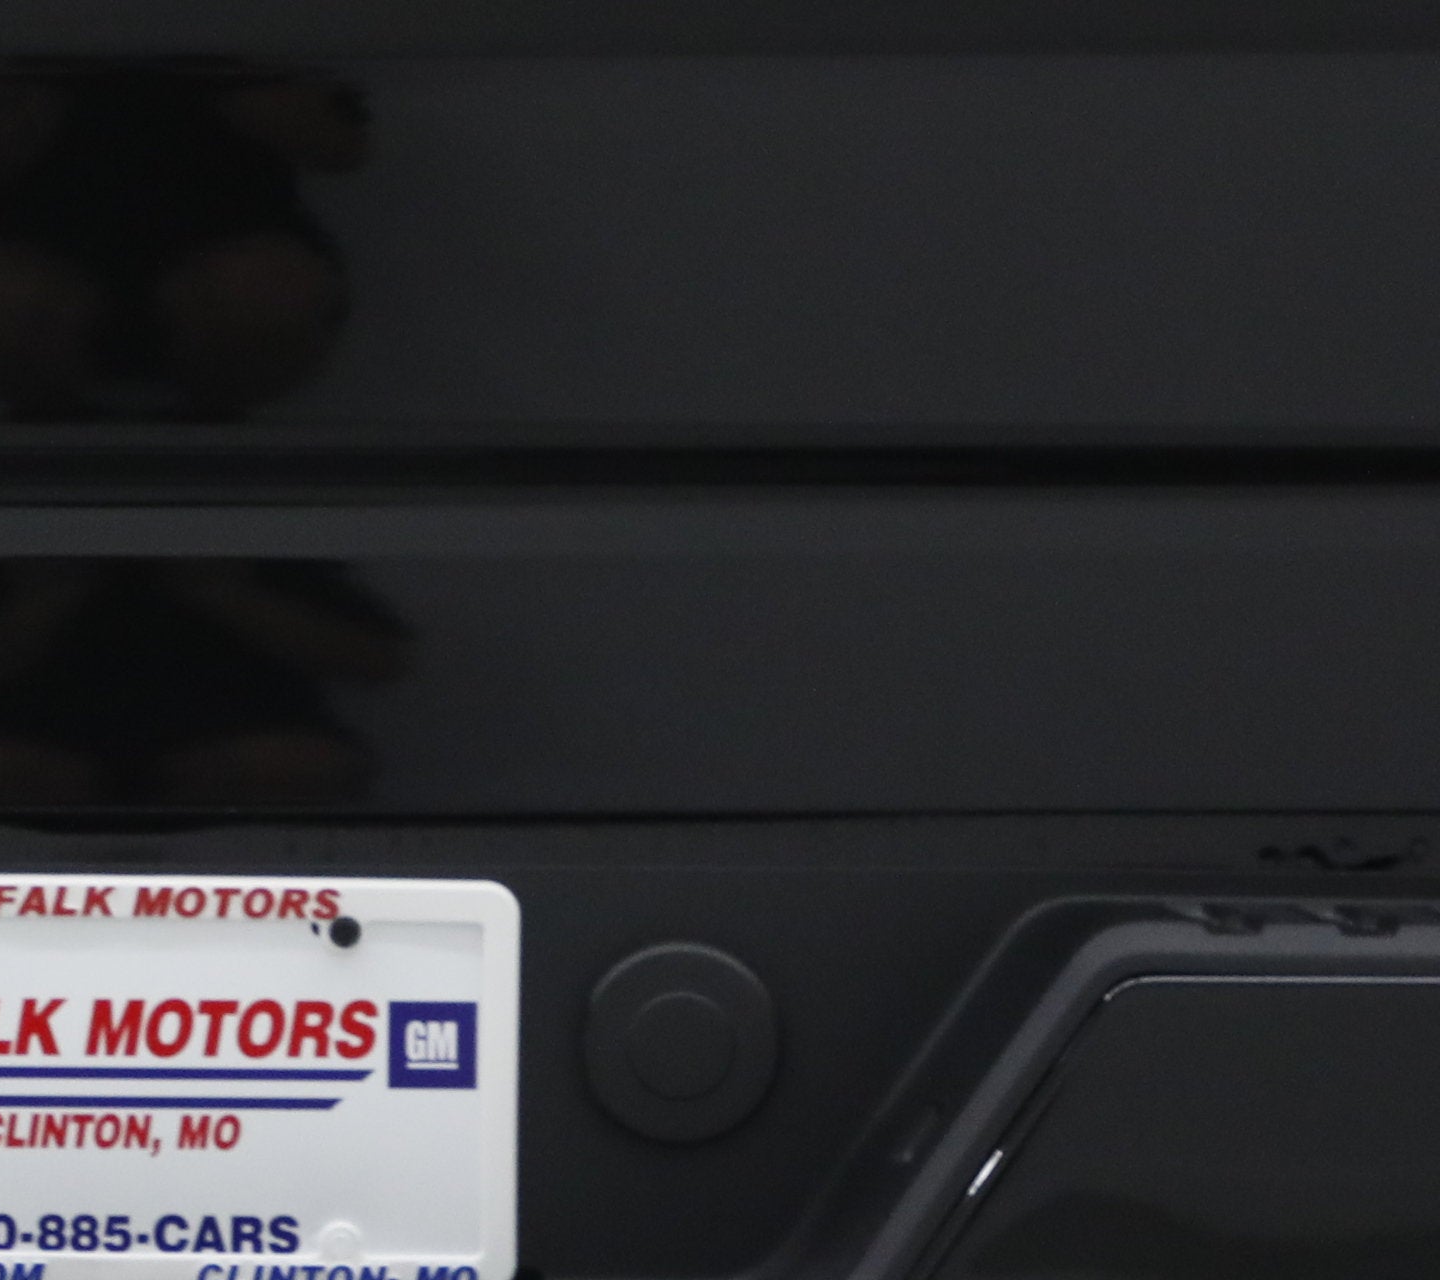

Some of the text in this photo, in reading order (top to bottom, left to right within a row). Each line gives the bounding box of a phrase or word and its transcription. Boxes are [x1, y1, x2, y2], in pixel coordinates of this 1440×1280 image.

[132, 886, 342, 921] MOTORS
[85, 998, 380, 1061] MOTORS
[404, 1019, 459, 1064] GM
[177, 1114, 243, 1151] MO
